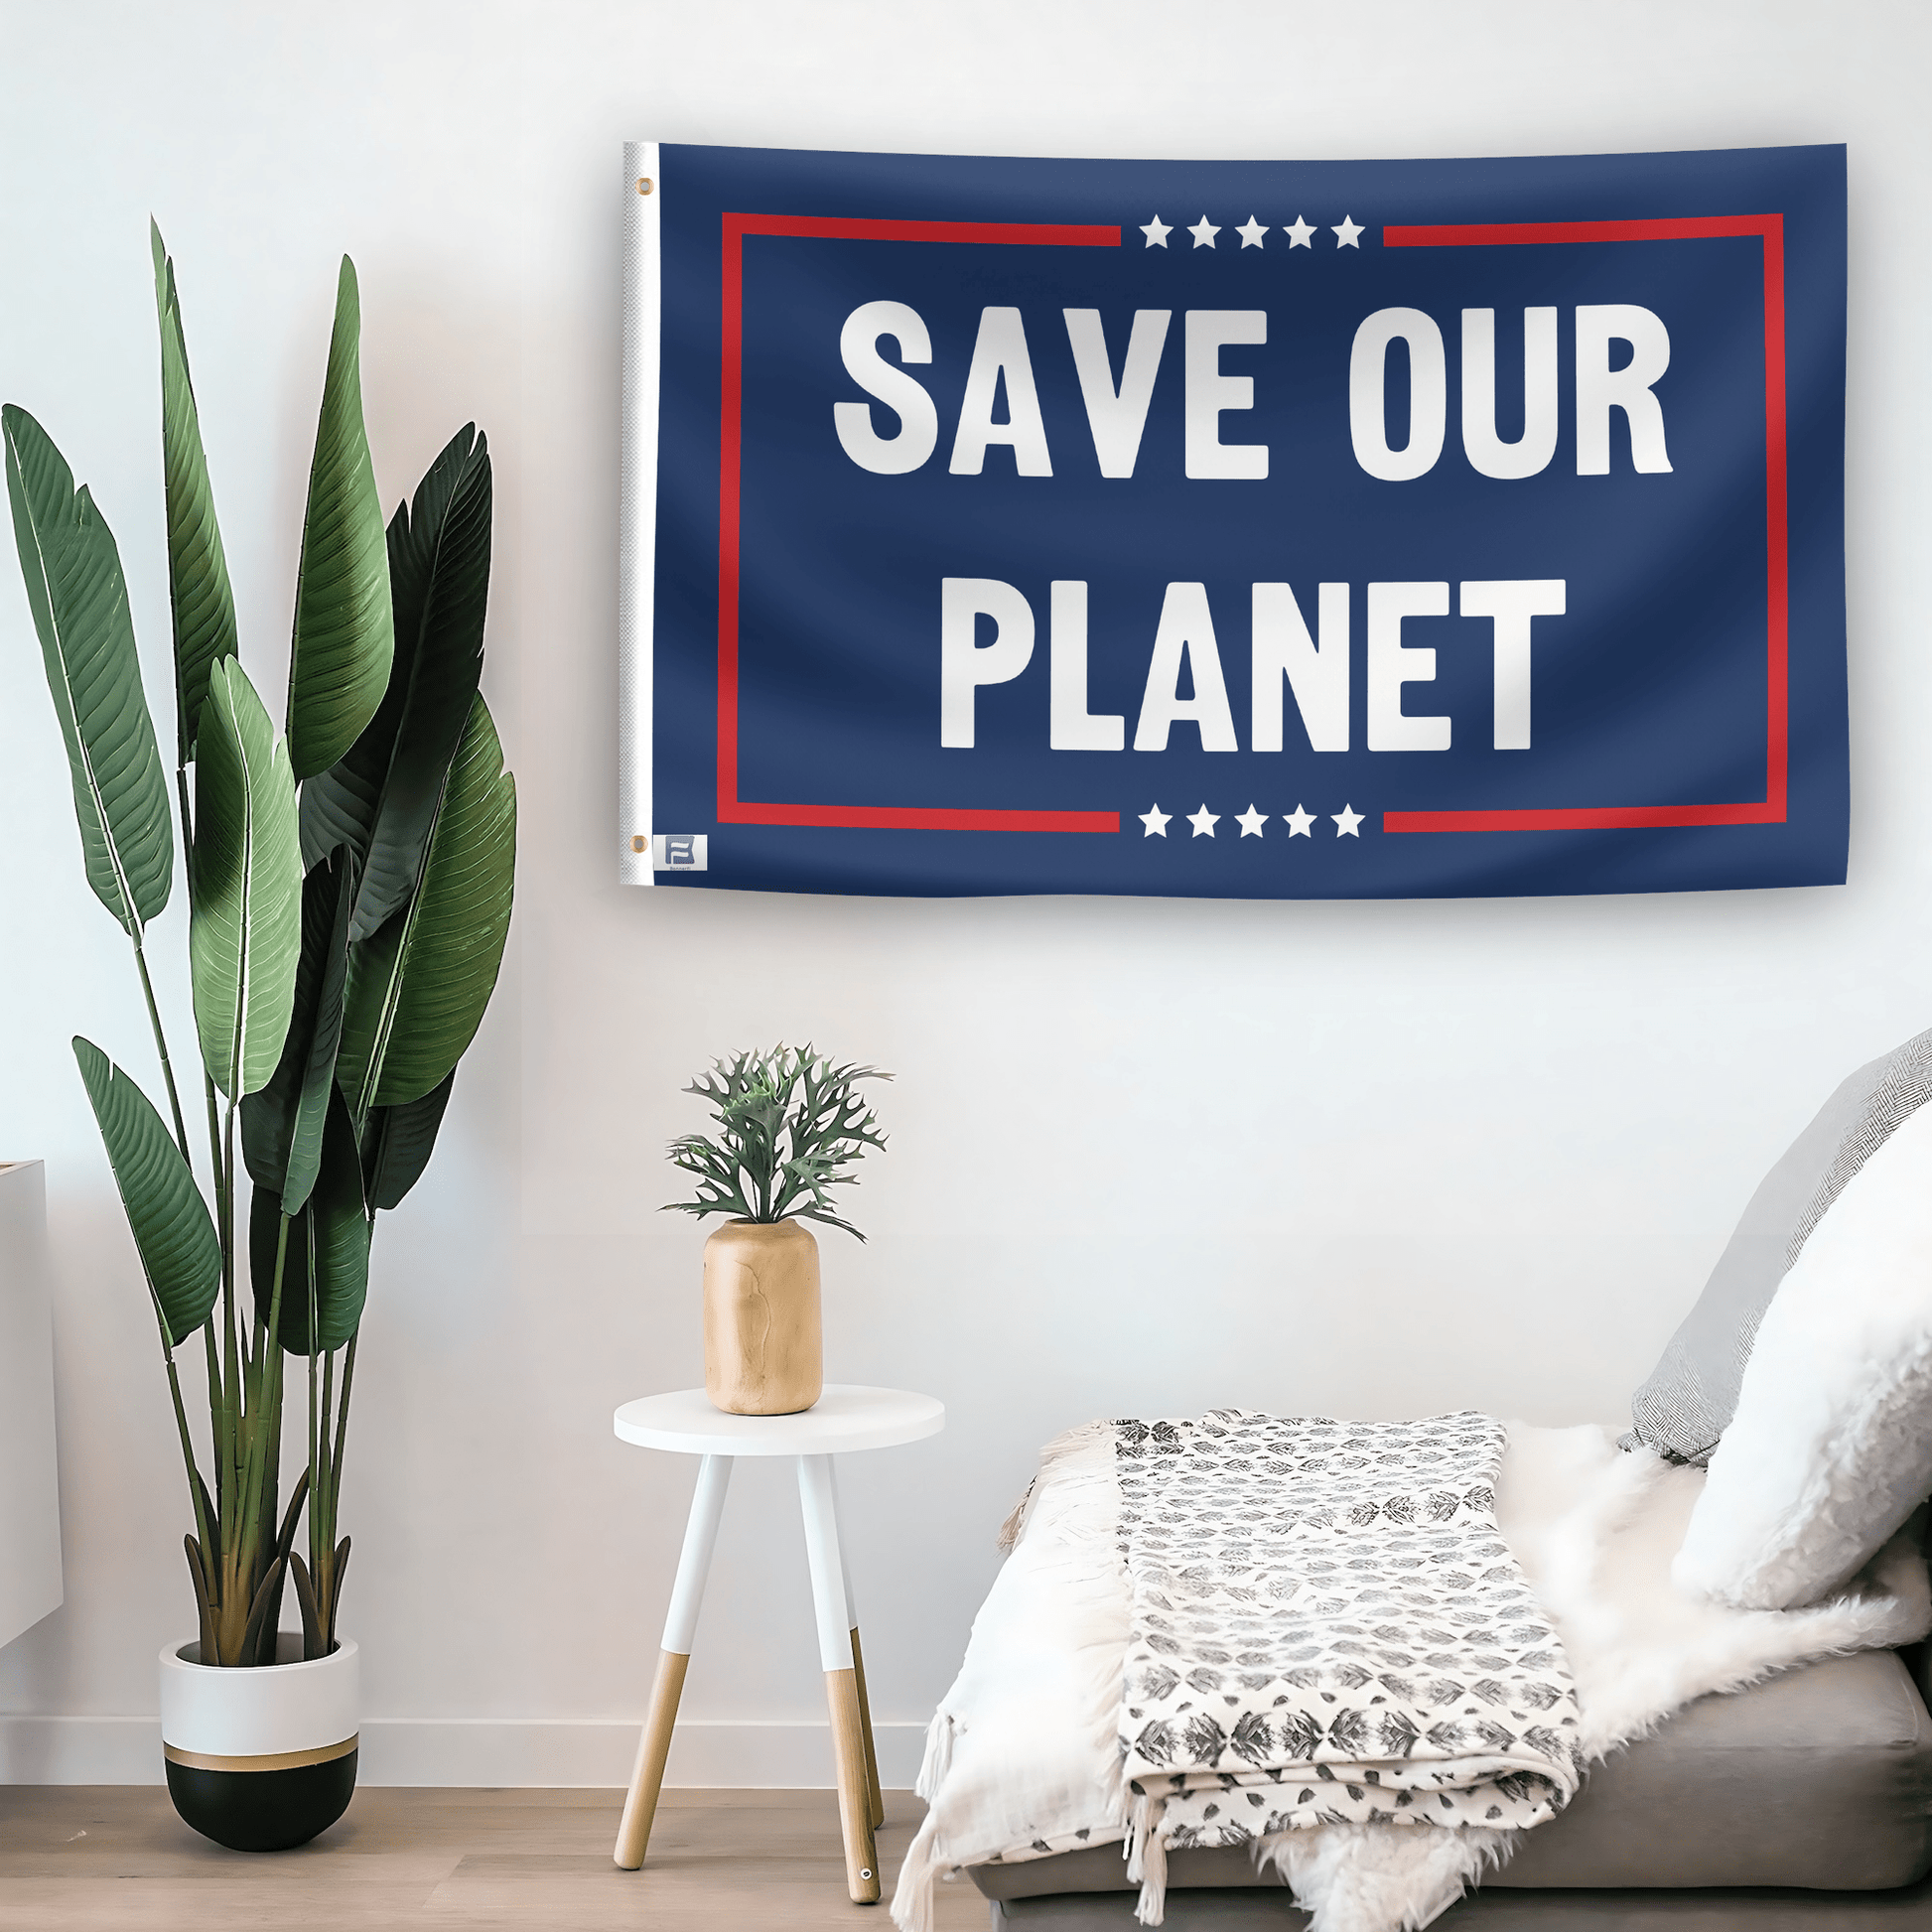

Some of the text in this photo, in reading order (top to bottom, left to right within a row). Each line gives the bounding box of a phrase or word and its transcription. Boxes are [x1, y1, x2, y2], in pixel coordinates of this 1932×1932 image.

[834, 300, 1674, 482] SAVE OUR
[940, 577, 1567, 753] PLANET
